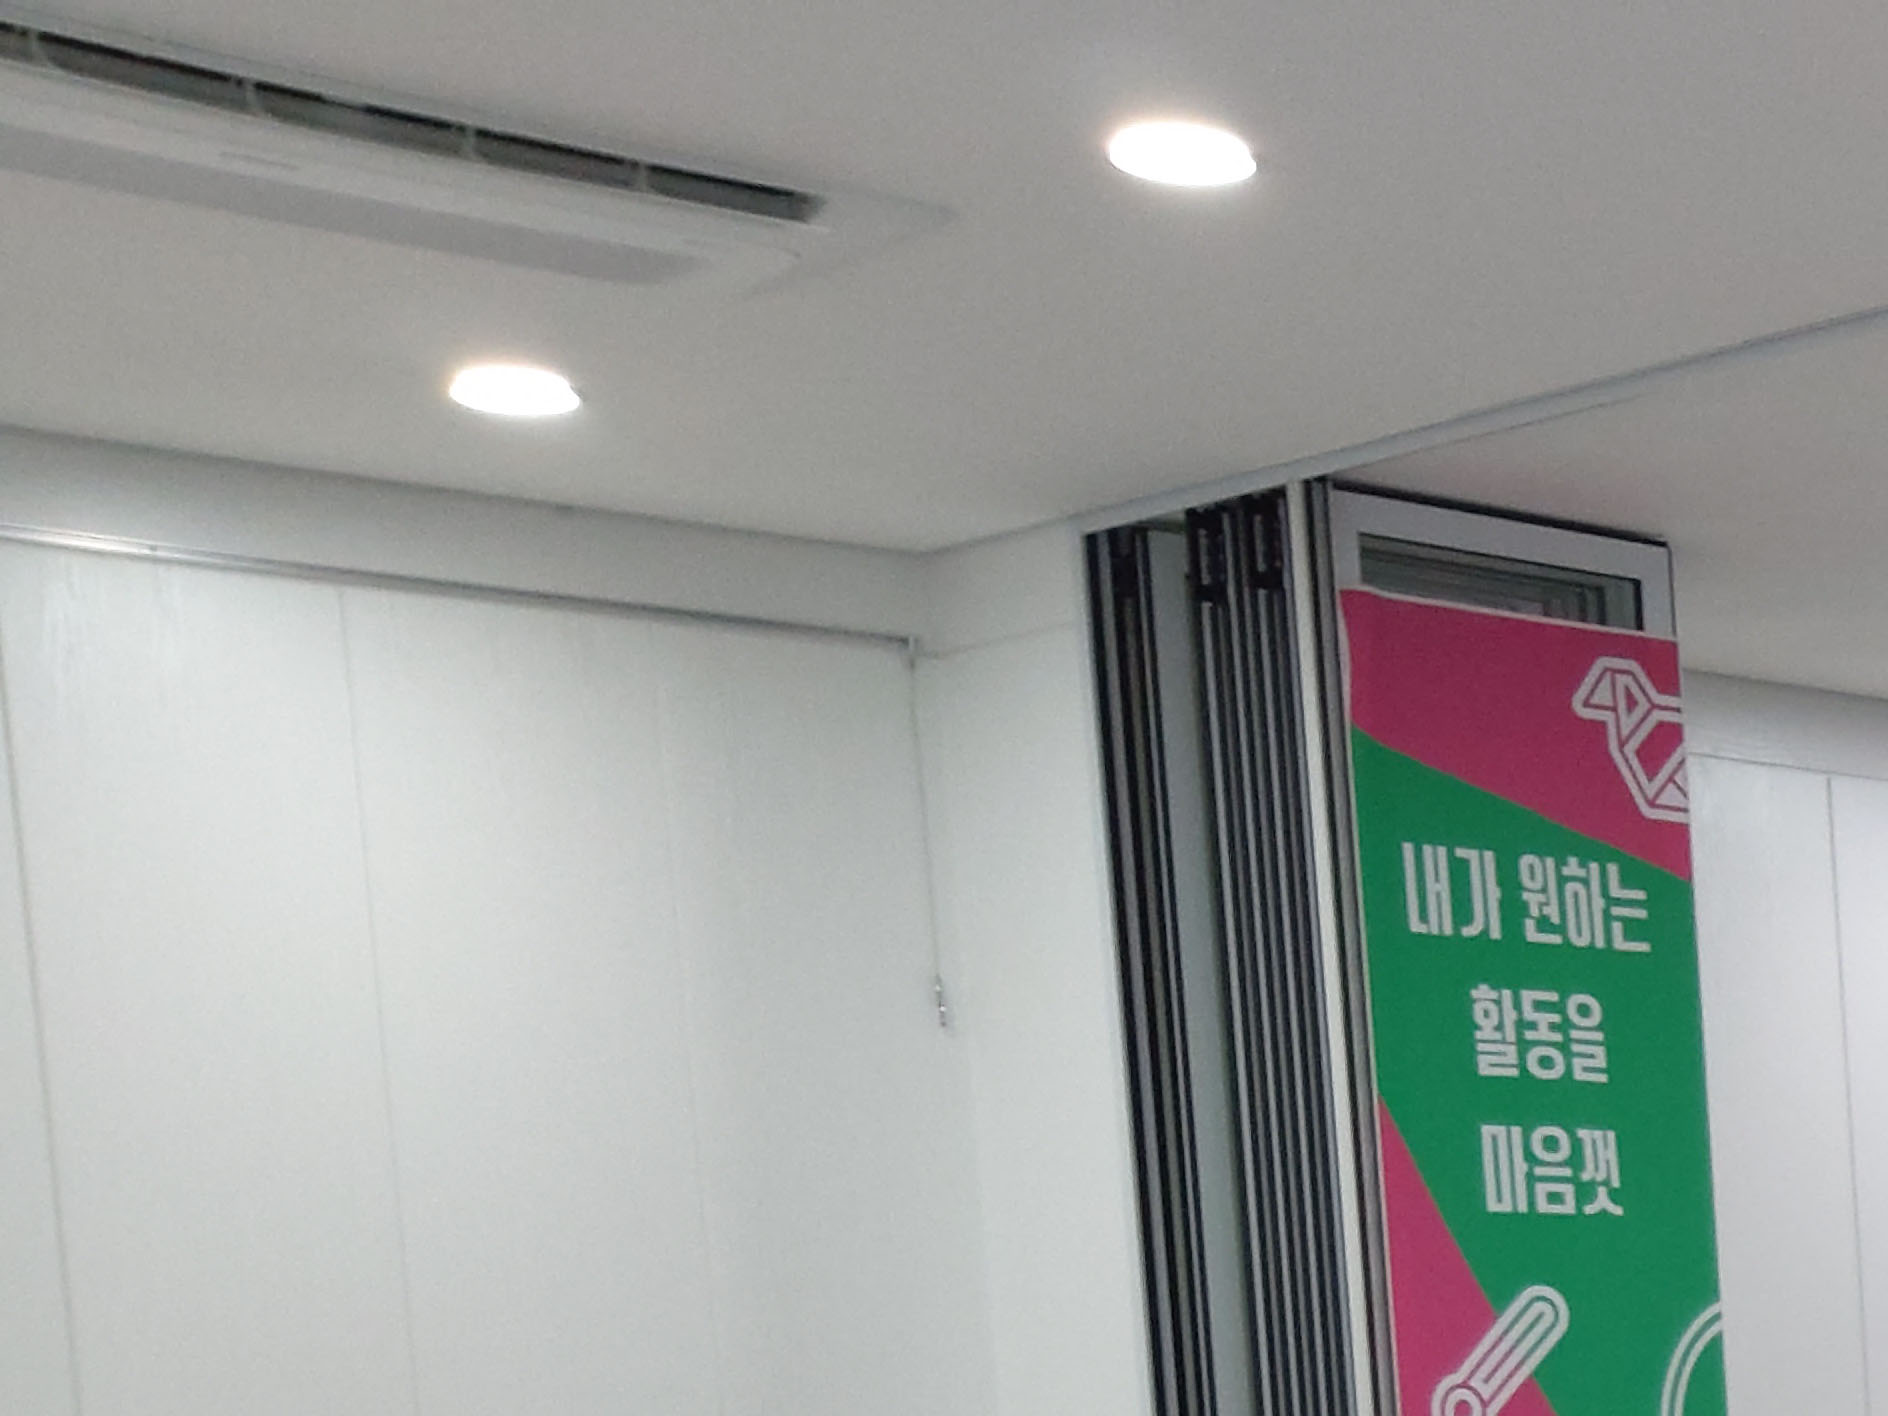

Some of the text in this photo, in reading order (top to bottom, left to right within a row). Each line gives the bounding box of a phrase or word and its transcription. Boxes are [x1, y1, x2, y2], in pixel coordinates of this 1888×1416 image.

[1402, 841, 1652, 953] 내가 원하는
[1470, 983, 1609, 1084] 활동을
[1481, 1123, 1624, 1216] 마음껏
